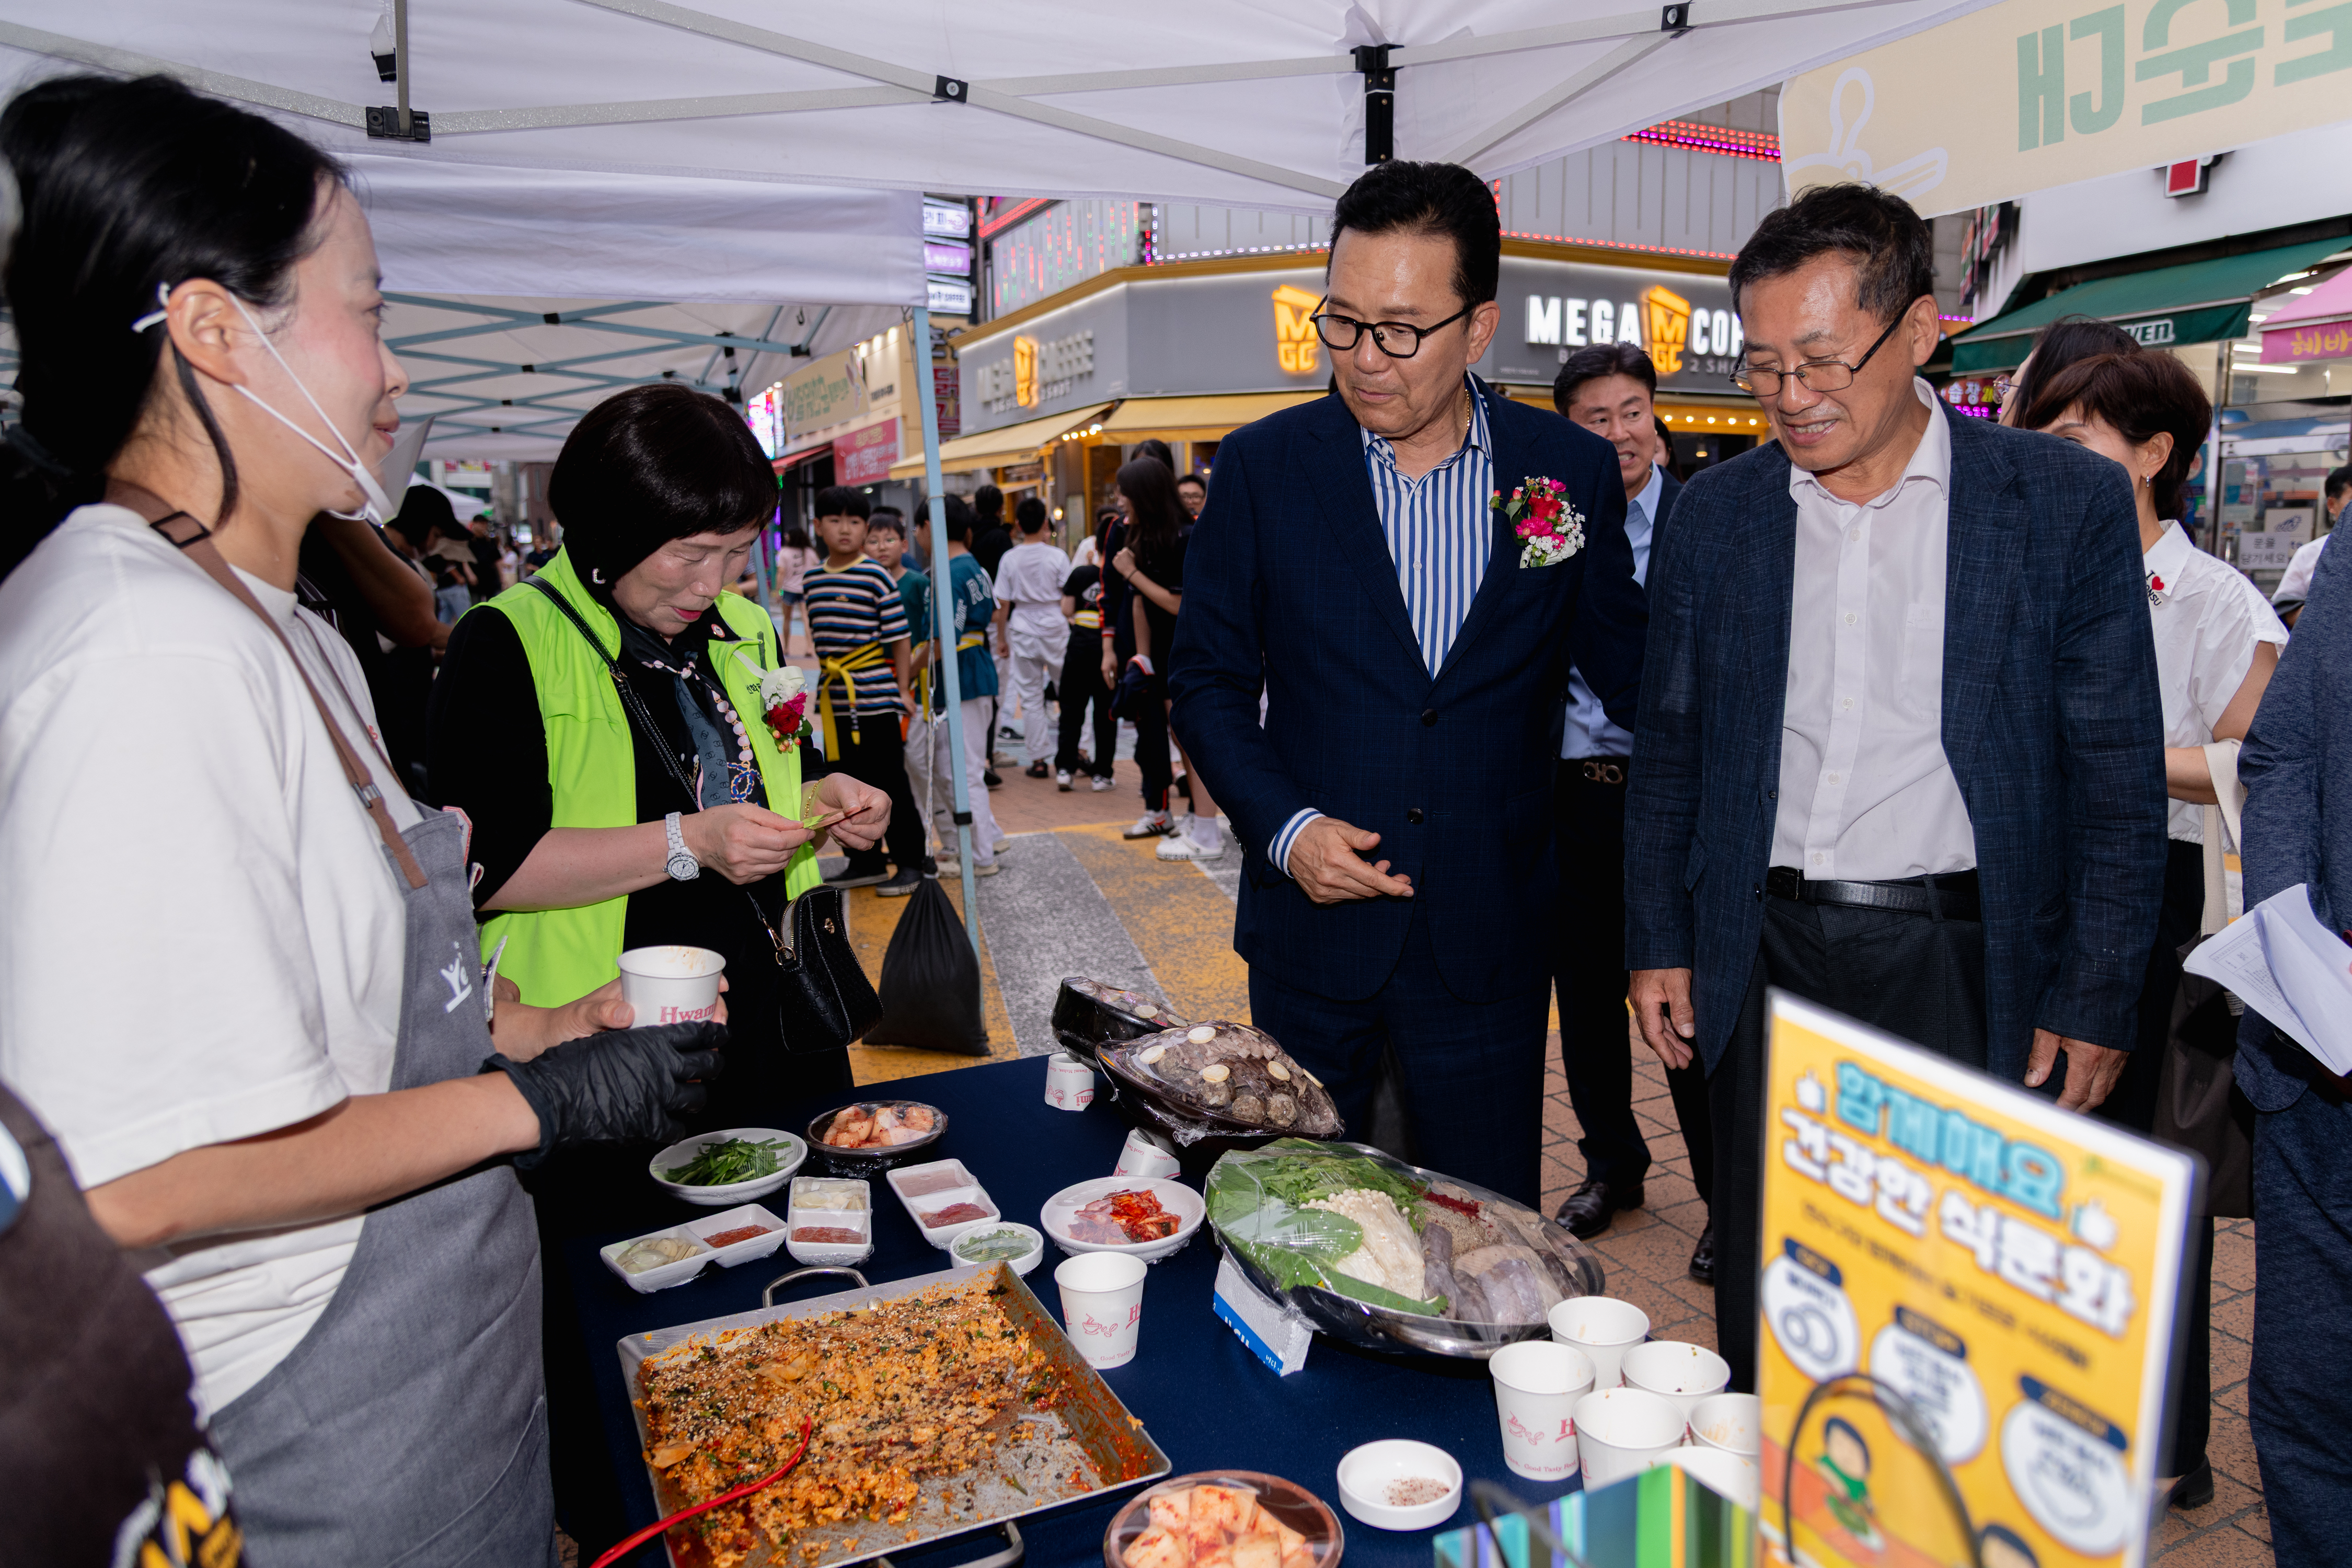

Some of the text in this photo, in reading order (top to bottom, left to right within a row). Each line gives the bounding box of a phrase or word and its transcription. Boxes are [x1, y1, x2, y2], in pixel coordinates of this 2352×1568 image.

[1526, 294, 1642, 347] MEGA
[2253, 537, 2276, 550] 문을
[2240, 552, 2286, 566] 당기세요
[1134, 1147, 1145, 1156] Good
[1100, 1353, 1116, 1362] Good
[1116, 1348, 1131, 1359] Tasty
[1524, 1463, 1542, 1472] Good
